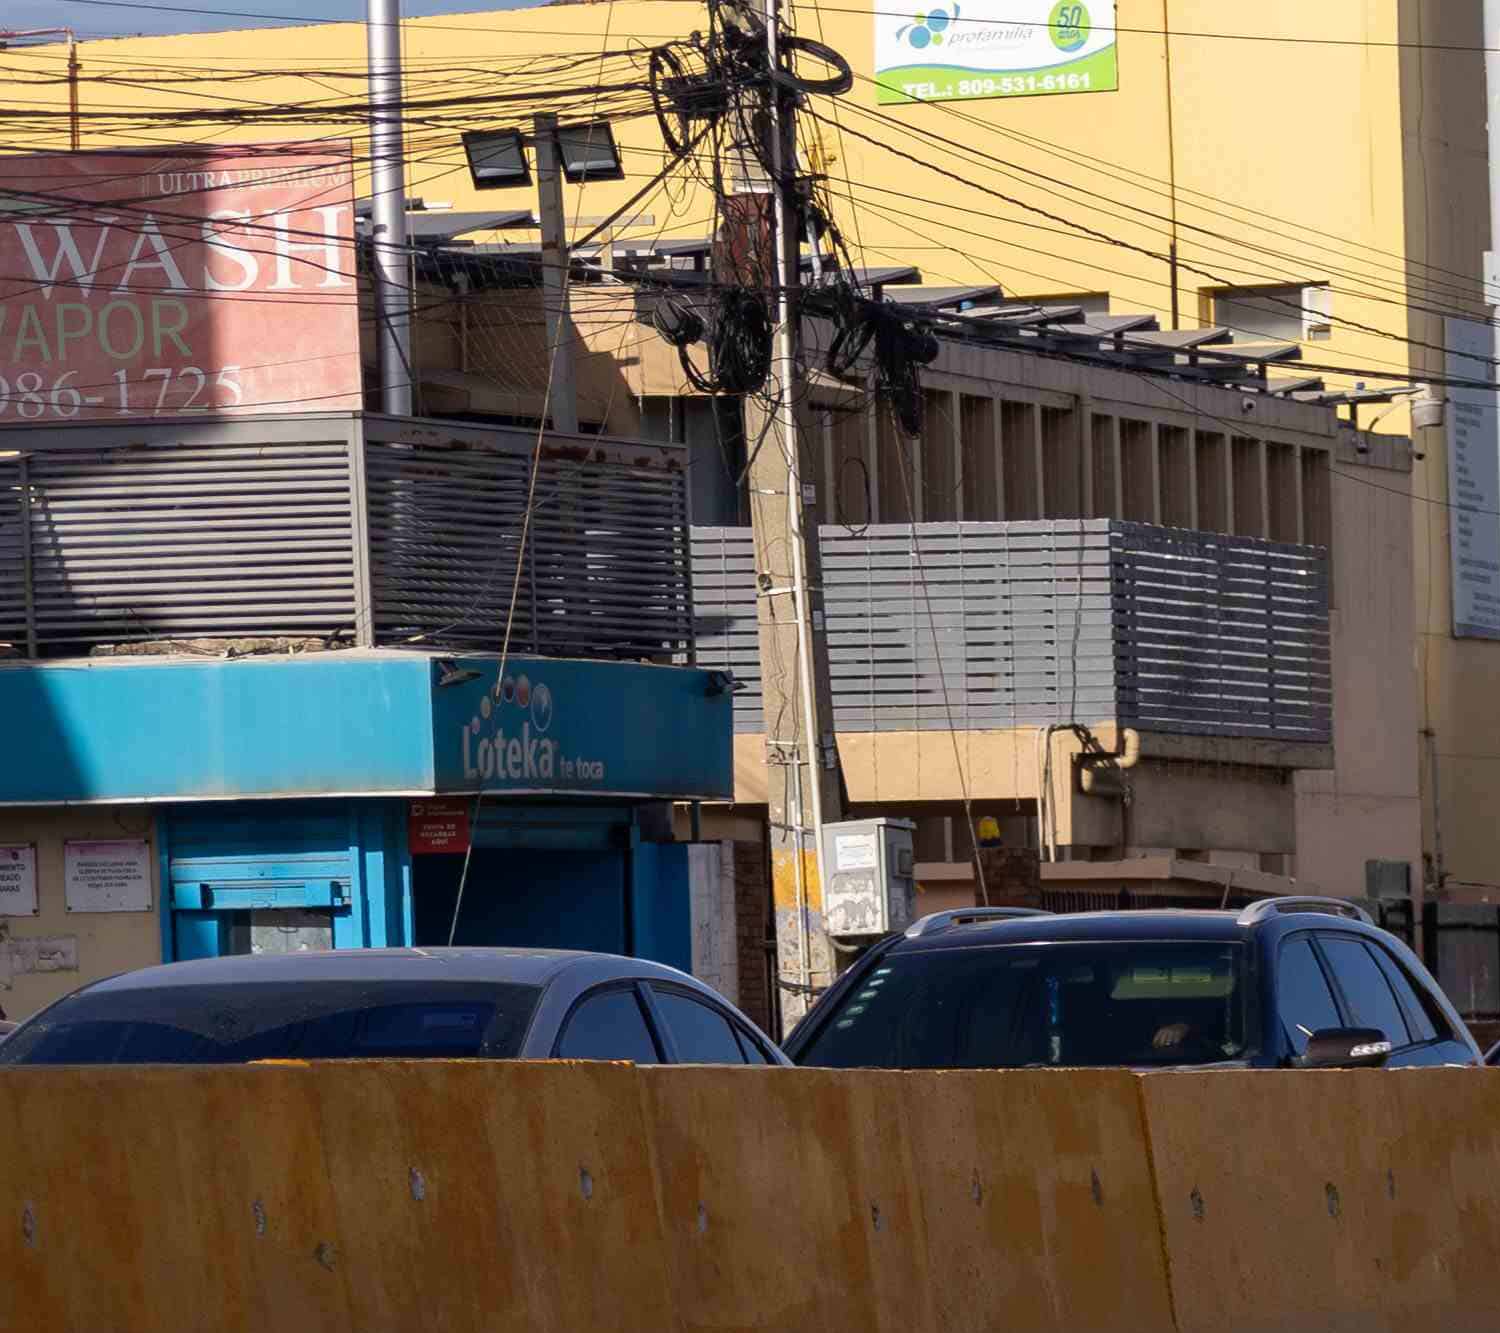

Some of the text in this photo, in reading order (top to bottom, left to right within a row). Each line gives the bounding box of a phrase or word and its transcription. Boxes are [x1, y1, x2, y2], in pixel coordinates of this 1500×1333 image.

[949, 25, 1034, 46] profamilia
[958, 72, 1091, 96] 809-531-6161
[158, 164, 347, 195] ULTRA PREMIUM
[10, 206, 354, 301] WASH
[0, 298, 193, 363] APOR
[463, 721, 555, 780] Loteka
[576, 757, 605, 780] toca
